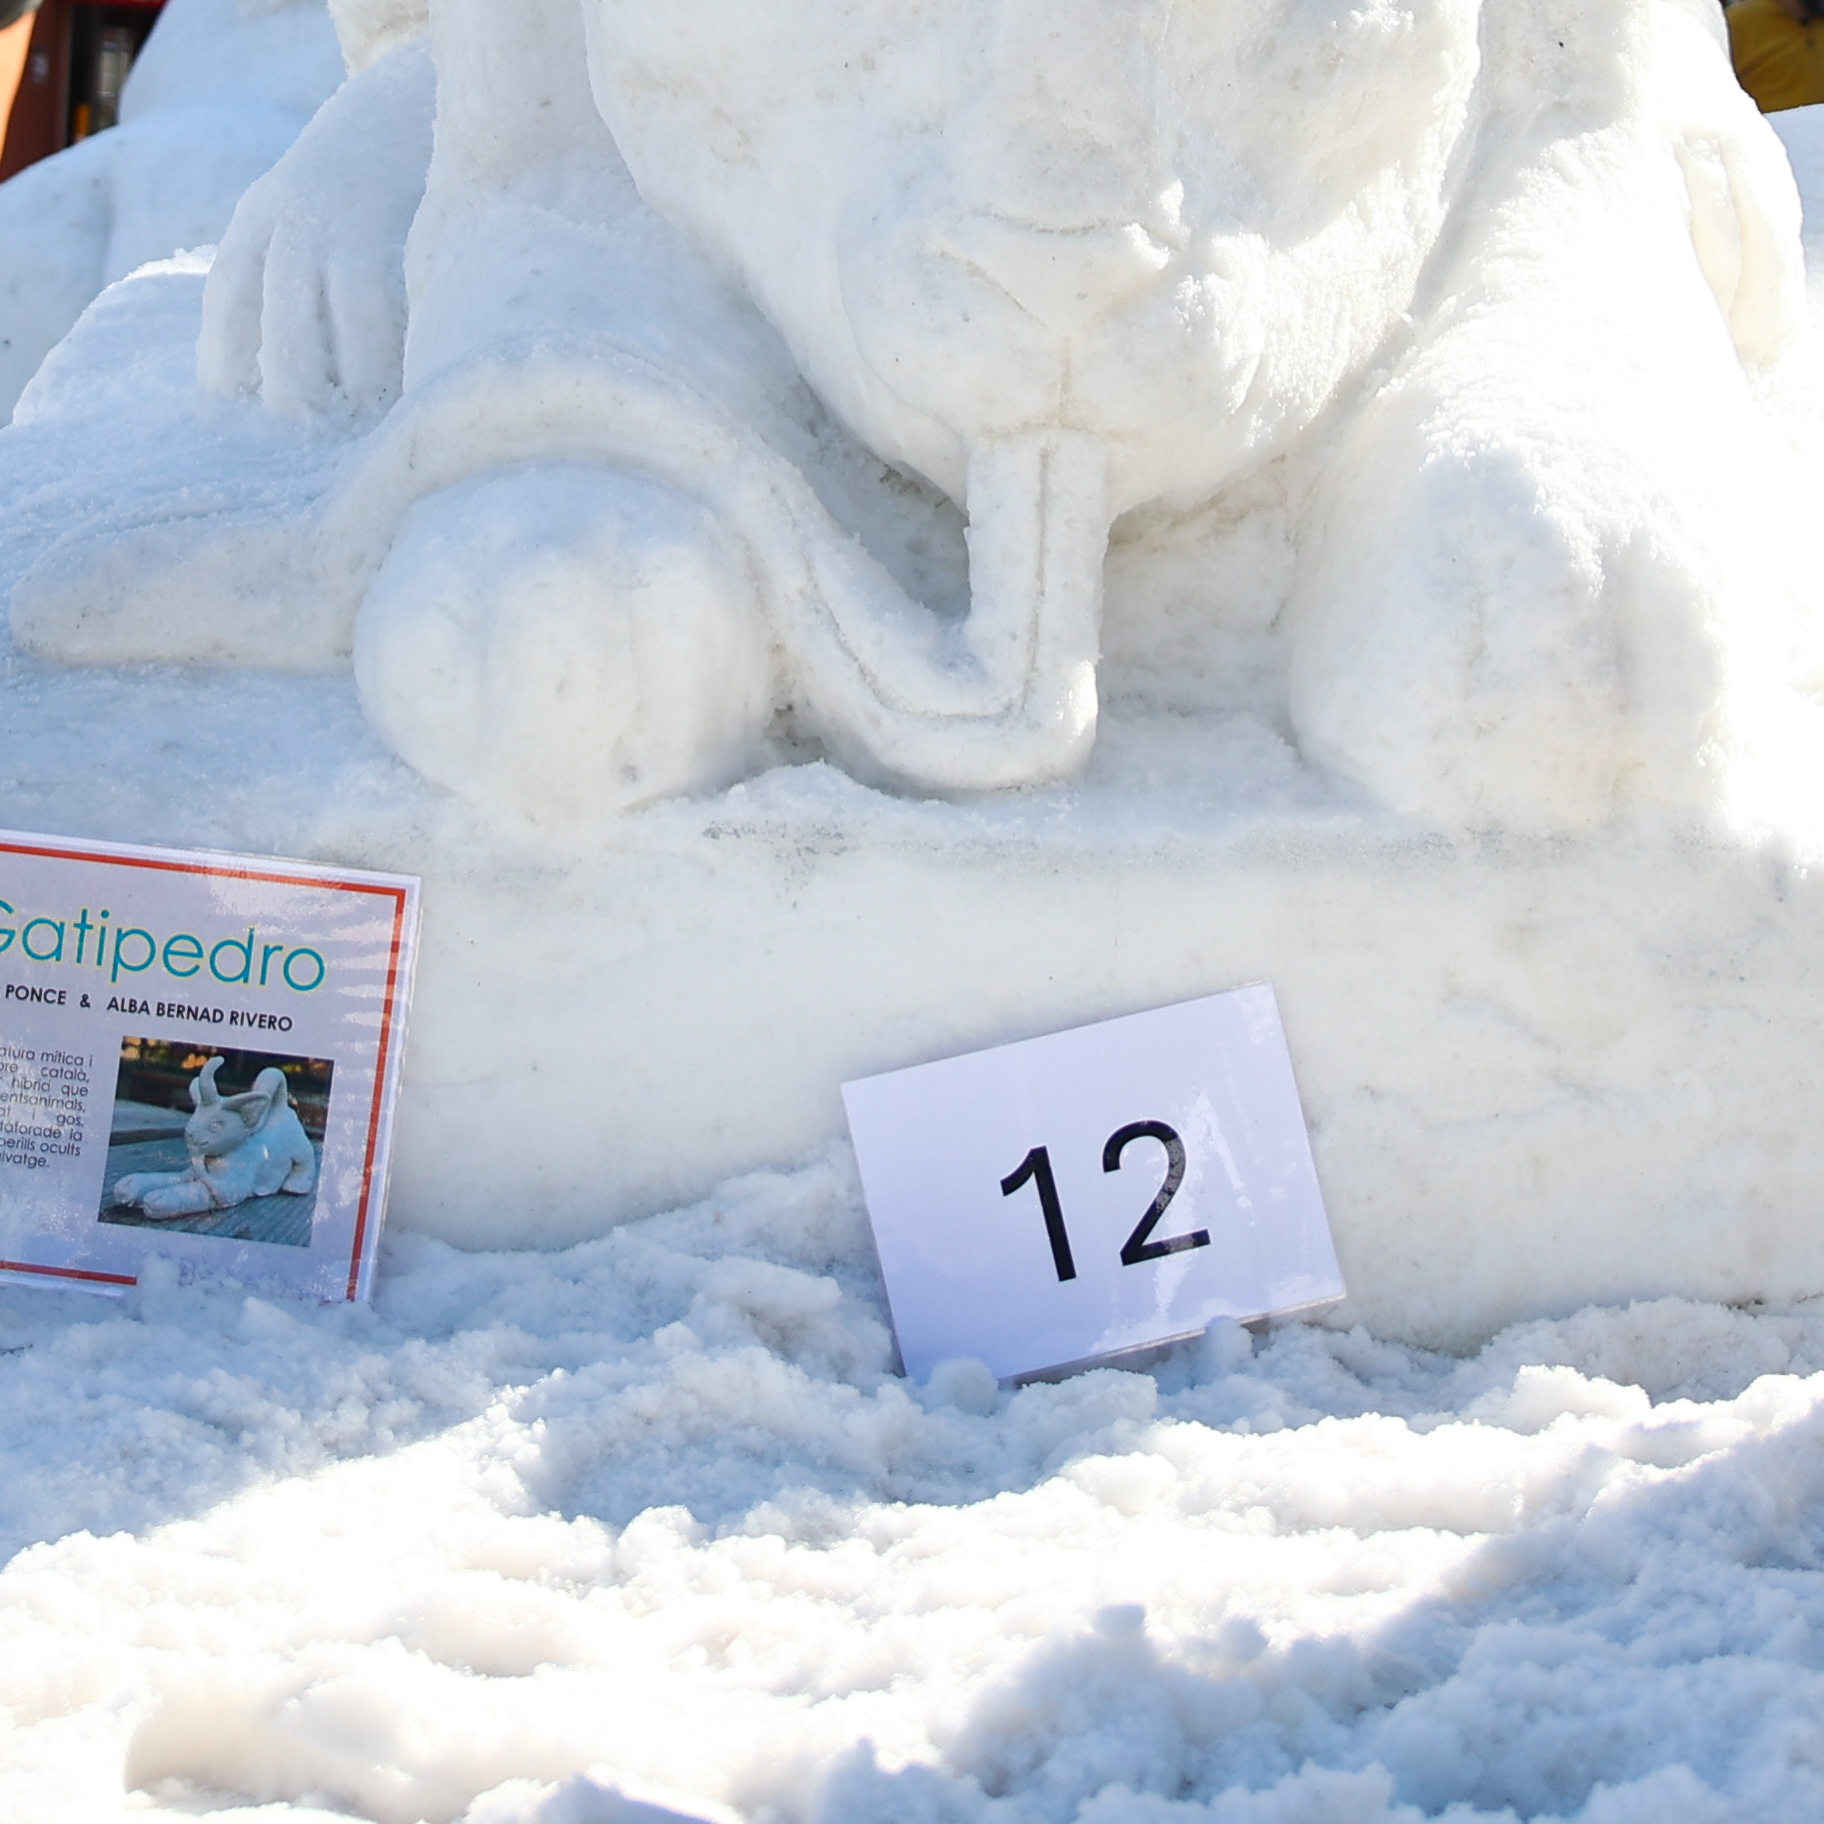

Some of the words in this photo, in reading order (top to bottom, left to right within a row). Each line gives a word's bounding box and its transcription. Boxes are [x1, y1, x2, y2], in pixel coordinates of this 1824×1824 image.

[6, 983, 67, 1006] PONCE
[79, 993, 92, 1009] &
[106, 996, 150, 1016] ALBA
[156, 1002, 225, 1024] BERNAD
[229, 1010, 293, 1032] RIVERO
[61, 1083, 88, 1097] que
[69, 1128, 83, 1142] la
[40, 1142, 81, 1157] ocults
[999, 1119, 1212, 1283] 12
